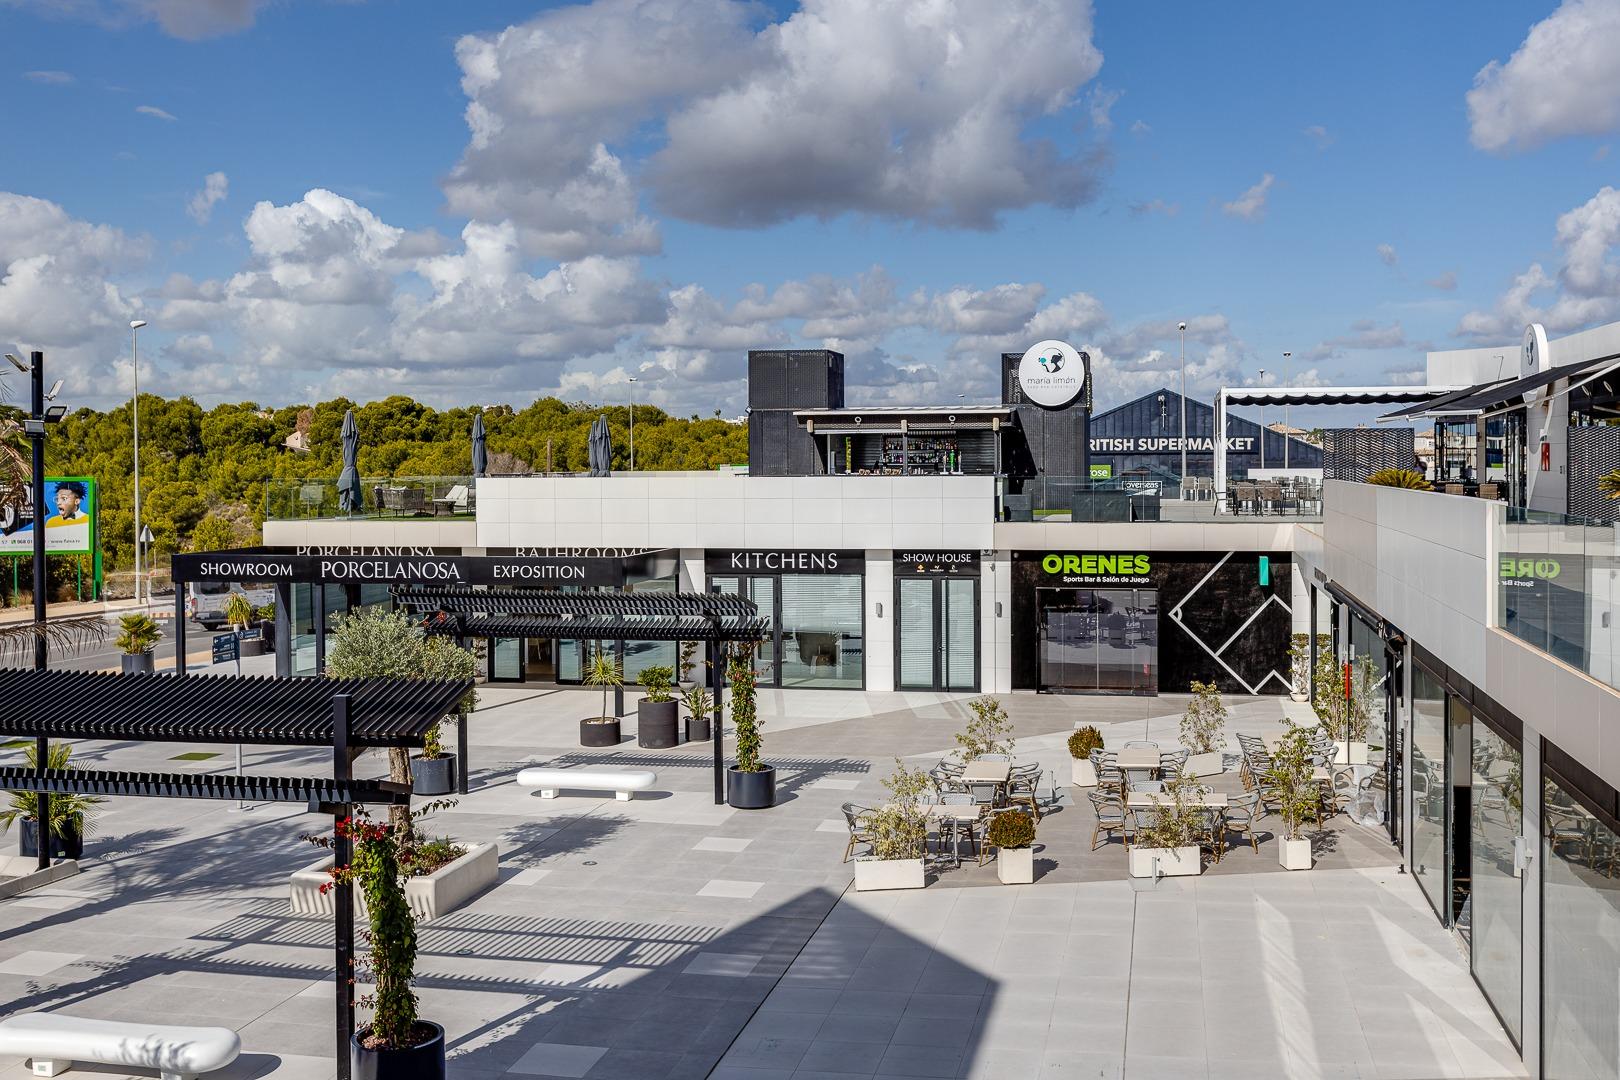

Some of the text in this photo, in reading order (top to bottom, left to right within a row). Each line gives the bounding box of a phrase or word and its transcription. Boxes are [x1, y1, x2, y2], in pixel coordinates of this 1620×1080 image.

[1089, 438, 1255, 451] RITISH SUPERMAKET
[731, 552, 838, 569] KITCHENS
[902, 553, 972, 563] SHOW HOUSE
[1042, 554, 1151, 574] ORENES
[200, 562, 293, 577] SHOWROOM
[321, 560, 461, 580] PORCELANOSA
[493, 564, 585, 579] EXPOSITION
[1102, 575, 1120, 583] Salón
[1129, 576, 1150, 584] Juego
